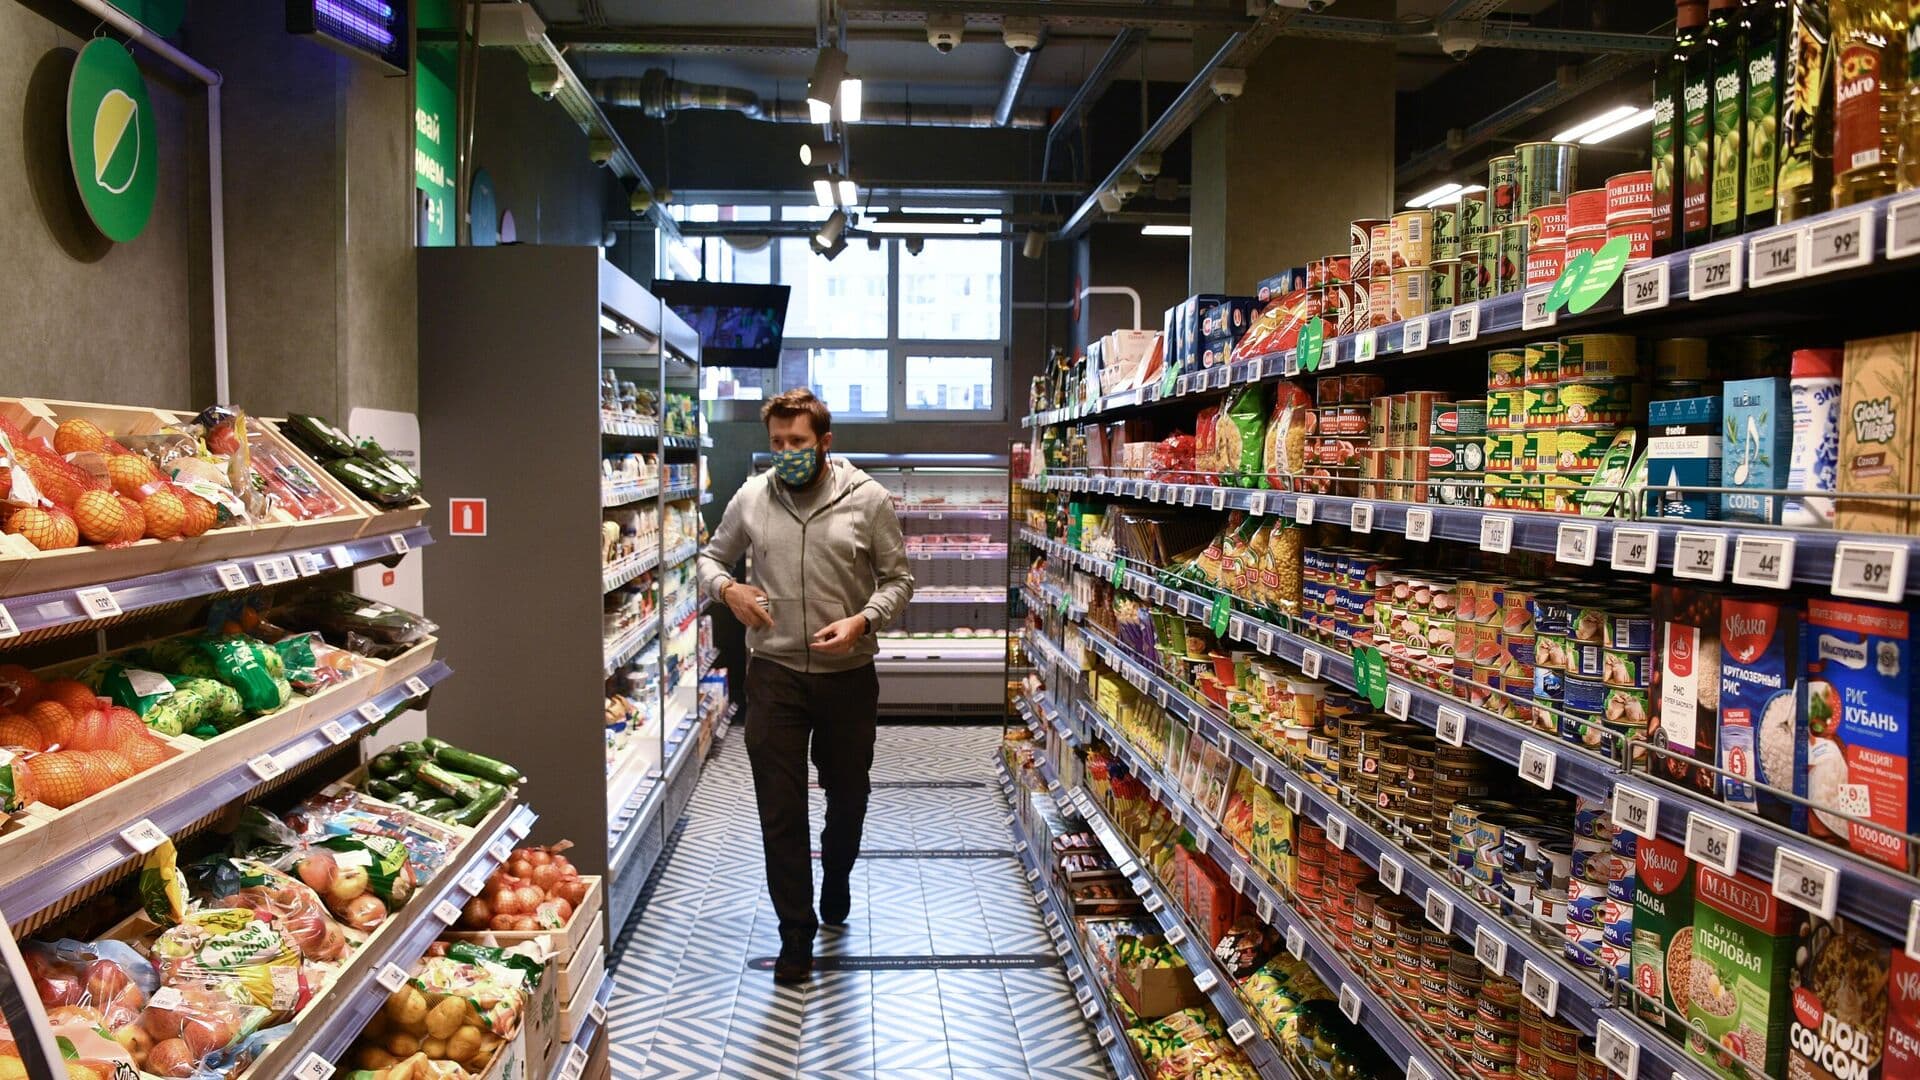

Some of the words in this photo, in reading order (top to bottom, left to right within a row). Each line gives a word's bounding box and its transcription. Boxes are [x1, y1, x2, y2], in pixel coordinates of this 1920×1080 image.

[1685, 193, 1706, 210] CLASSIC
[1834, 234, 1852, 254] 99
[1770, 248, 1790, 268] 114
[1706, 265, 1725, 283] 279
[1637, 281, 1654, 299] 269
[1853, 397, 1896, 423] Global
[1856, 420, 1896, 443] Village
[1729, 494, 1760, 510] СОЛЬ
[1630, 544, 1641, 559] 49
[1697, 550, 1708, 566] 32
[1759, 554, 1774, 572] 44
[1863, 563, 1883, 582] 89
[1725, 613, 1768, 641] Увелка
[1722, 664, 1781, 689] КРУГЛОЗЕРНЫЙ
[1673, 685, 1685, 696] РИС
[1723, 678, 1740, 696] РИС
[1846, 687, 1868, 707] РИС
[1845, 706, 1898, 733] КУБАНЬ
[1533, 760, 1543, 774] 99
[1733, 755, 1741, 774] 5
[1858, 750, 1893, 768] АКЦИЯ!
[1628, 804, 1642, 822] 119
[1706, 837, 1722, 856] 86
[1858, 825, 1878, 843] 000
[1878, 831, 1901, 851] 000
[1641, 847, 1678, 875] Увелка
[1801, 877, 1817, 897] 83
[1636, 889, 1666, 917] ПОЛБА
[1714, 923, 1745, 946] КРУПА
[1700, 928, 1762, 974] ПЕРЛОВАЯ
[1644, 971, 1651, 988] 5
[1536, 984, 1546, 999] 53
[1794, 992, 1819, 1022] Увелка
[1822, 1012, 1869, 1064] ПОД
[1613, 1046, 1624, 1063] 99
[1790, 1022, 1869, 1080] СОУСОМ
